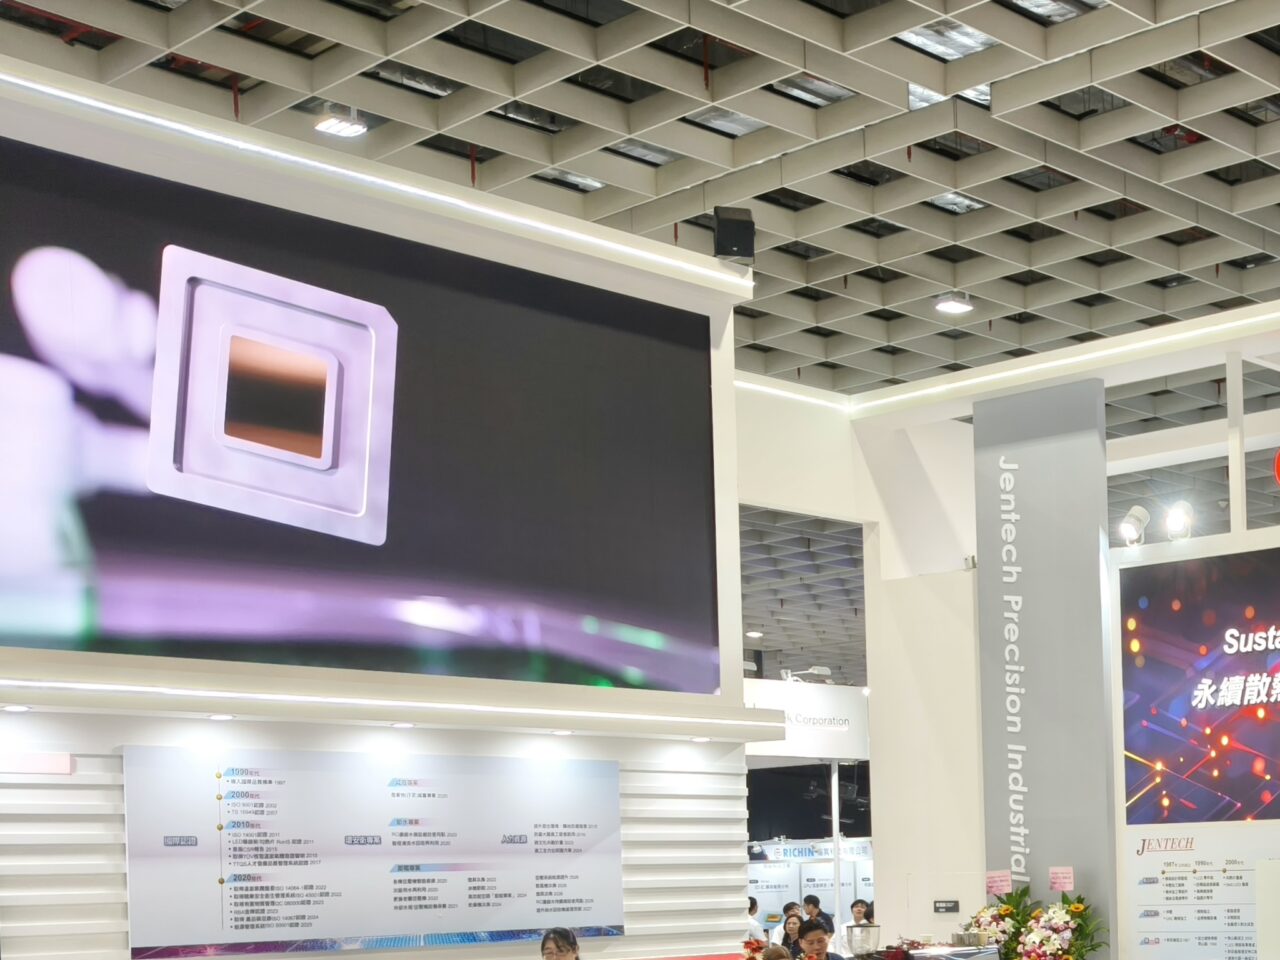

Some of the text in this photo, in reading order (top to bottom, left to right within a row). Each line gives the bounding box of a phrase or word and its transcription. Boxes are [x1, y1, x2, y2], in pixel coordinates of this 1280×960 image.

[998, 456, 1031, 883] Jentech Precision Industrial
[795, 713, 850, 727] Corporation
[783, 847, 815, 858] RICHIN
[1136, 837, 1195, 856] JENTECH
